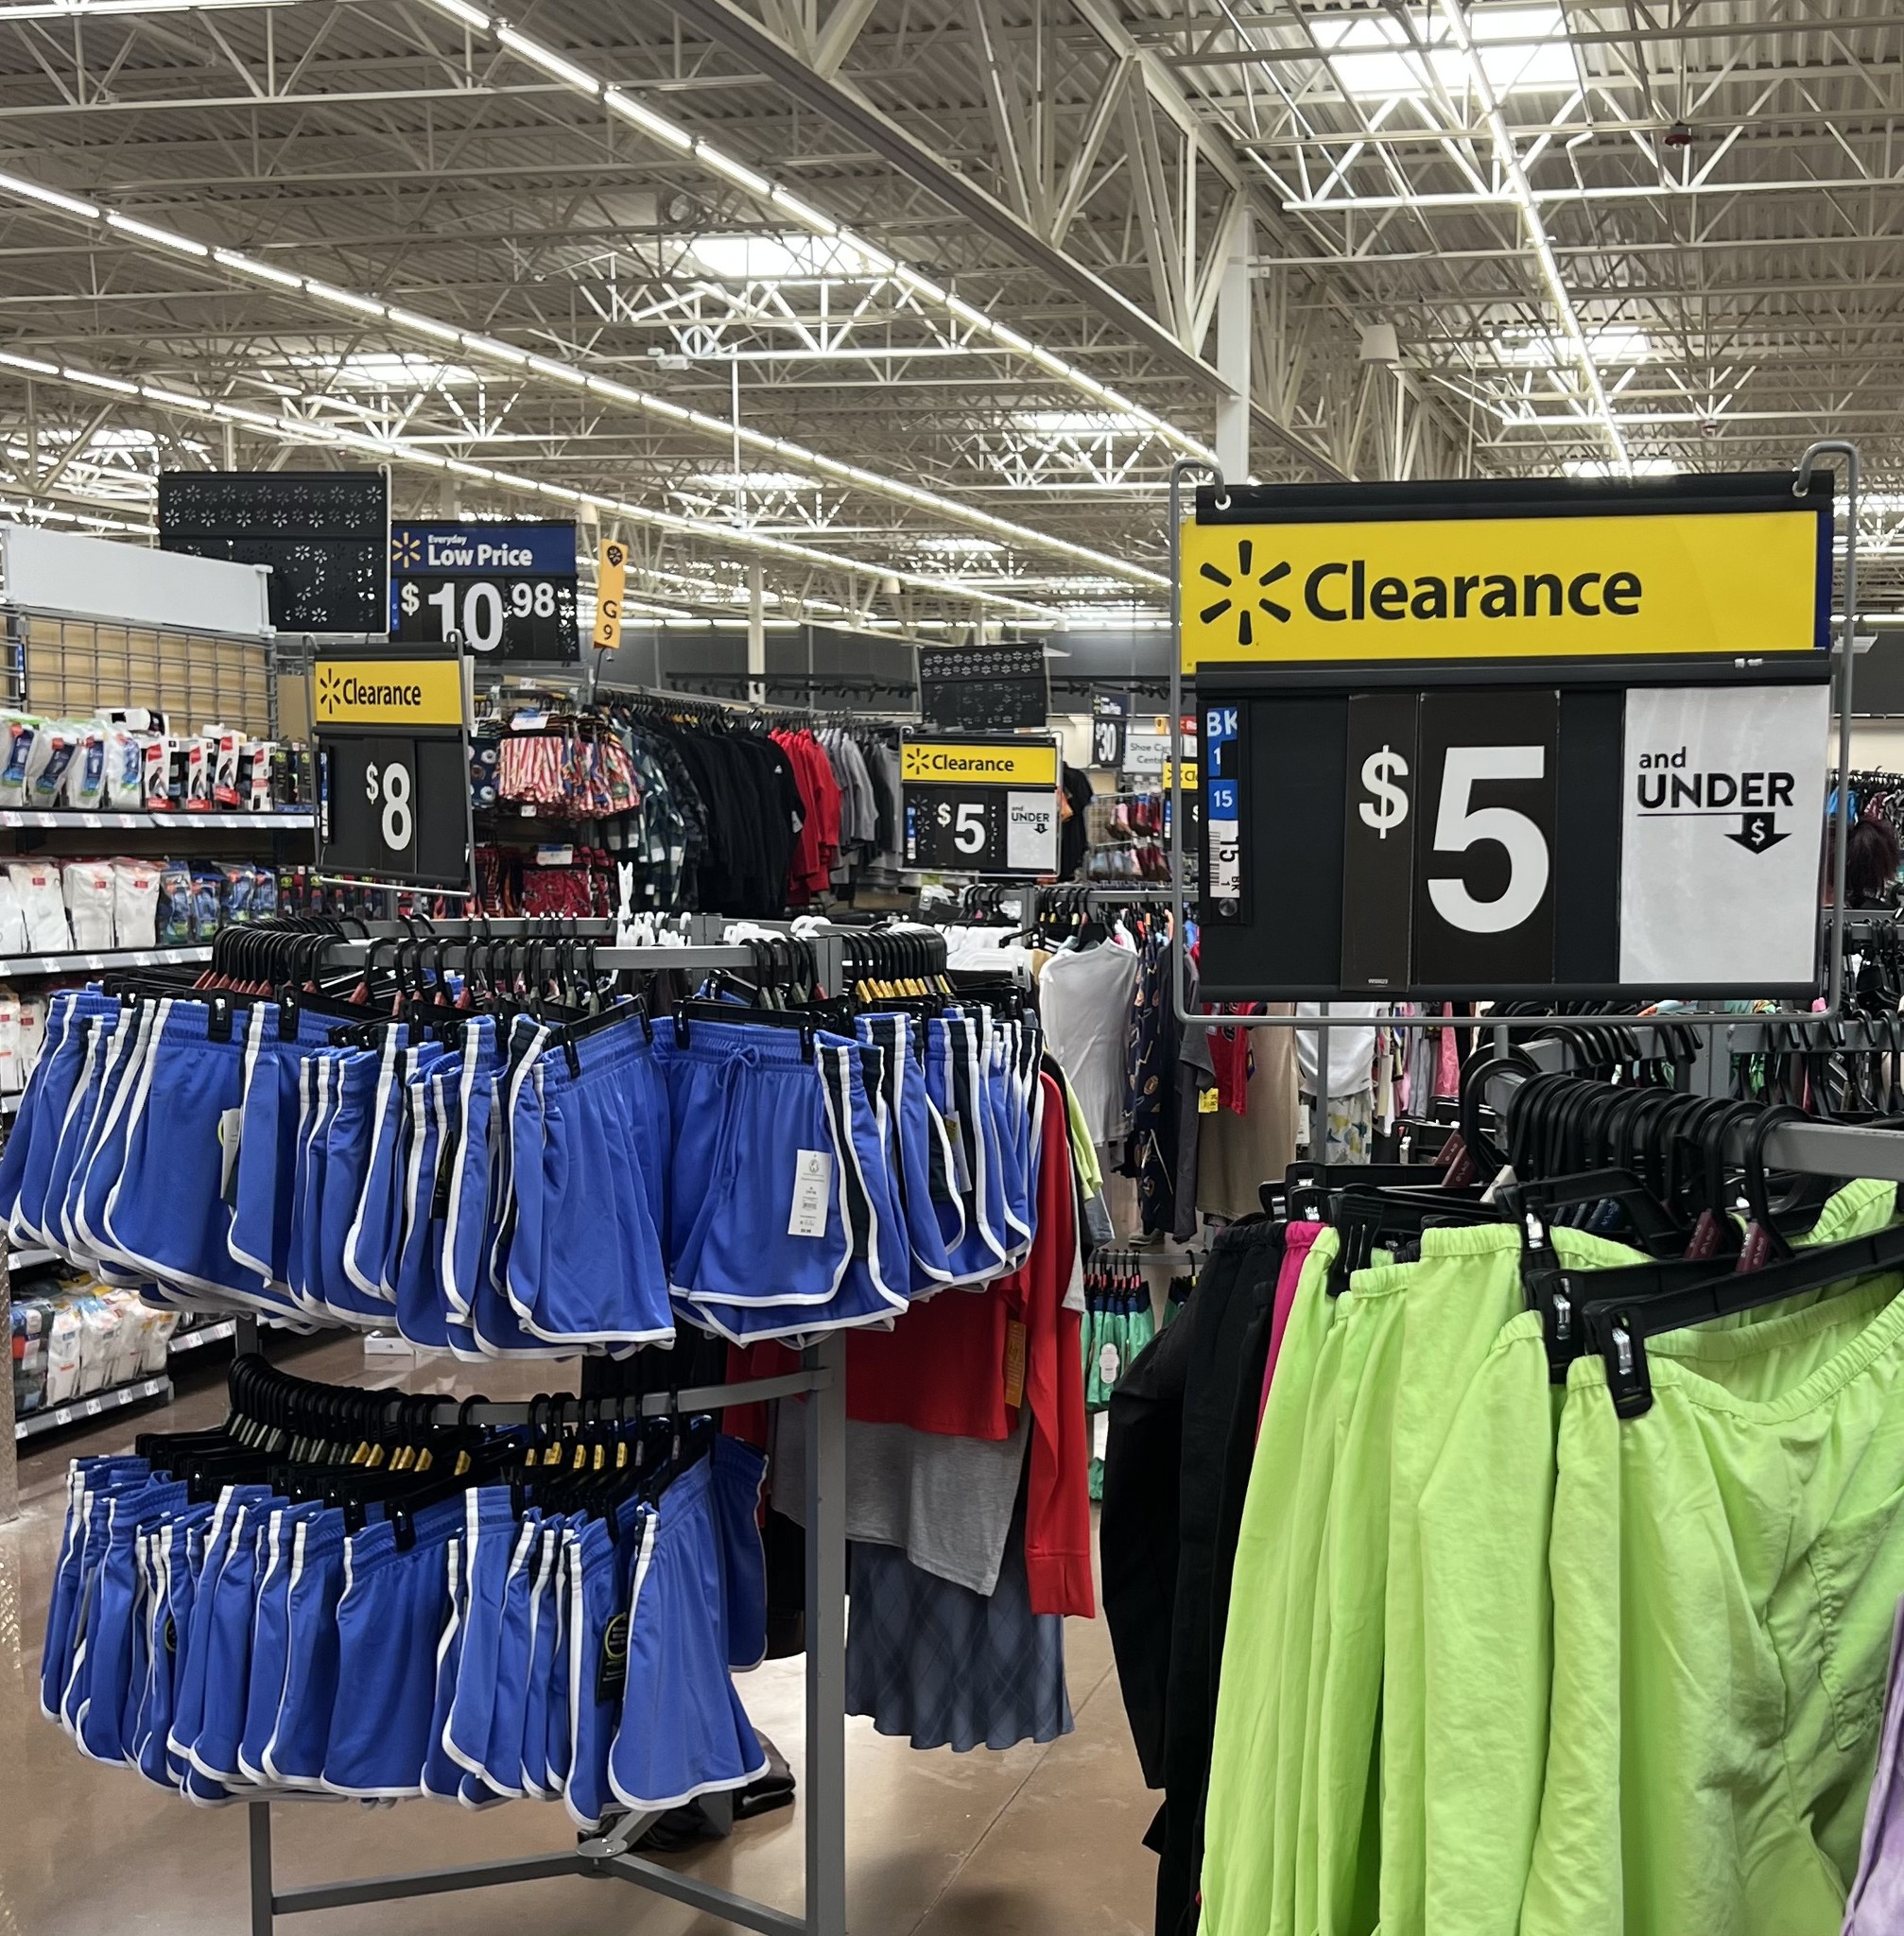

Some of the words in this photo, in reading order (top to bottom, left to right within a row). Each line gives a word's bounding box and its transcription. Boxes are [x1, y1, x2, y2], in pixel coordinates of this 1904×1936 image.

[428, 535, 467, 545] Everyday
[428, 544, 474, 566] Low
[477, 543, 533, 566] Price
[1304, 560, 1642, 622] Clearance
[602, 600, 617, 619] G
[602, 625, 614, 640] 9
[342, 678, 422, 706] Clearance
[1206, 710, 1238, 737] BK
[932, 754, 1014, 772] Clearance
[1638, 746, 1688, 769] and
[1214, 790, 1233, 807] 15
[1637, 771, 1795, 809] UNDER
[1012, 812, 1050, 822] UNDER
